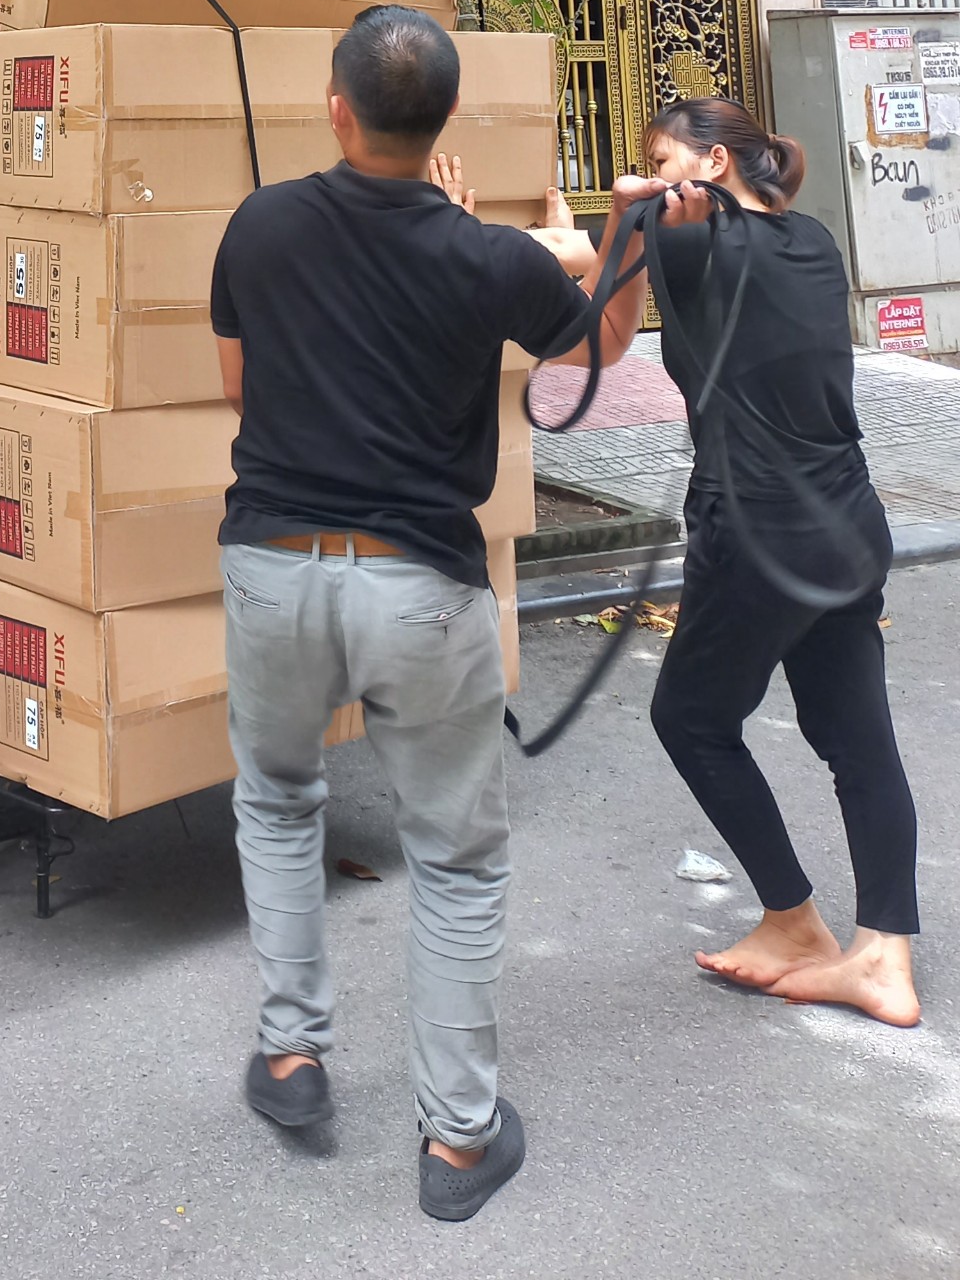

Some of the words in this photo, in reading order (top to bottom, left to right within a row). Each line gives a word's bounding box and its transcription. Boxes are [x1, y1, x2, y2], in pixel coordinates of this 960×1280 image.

[60, 57, 69, 103] XIFU
[35, 123, 43, 140] 75
[16, 267, 24, 295] 55
[885, 304, 902, 318] LẮP
[903, 305, 921, 317] ĐẶT
[880, 318, 922, 330] INTERNET
[54, 632, 65, 685] XIFU
[27, 707, 36, 726] 75
